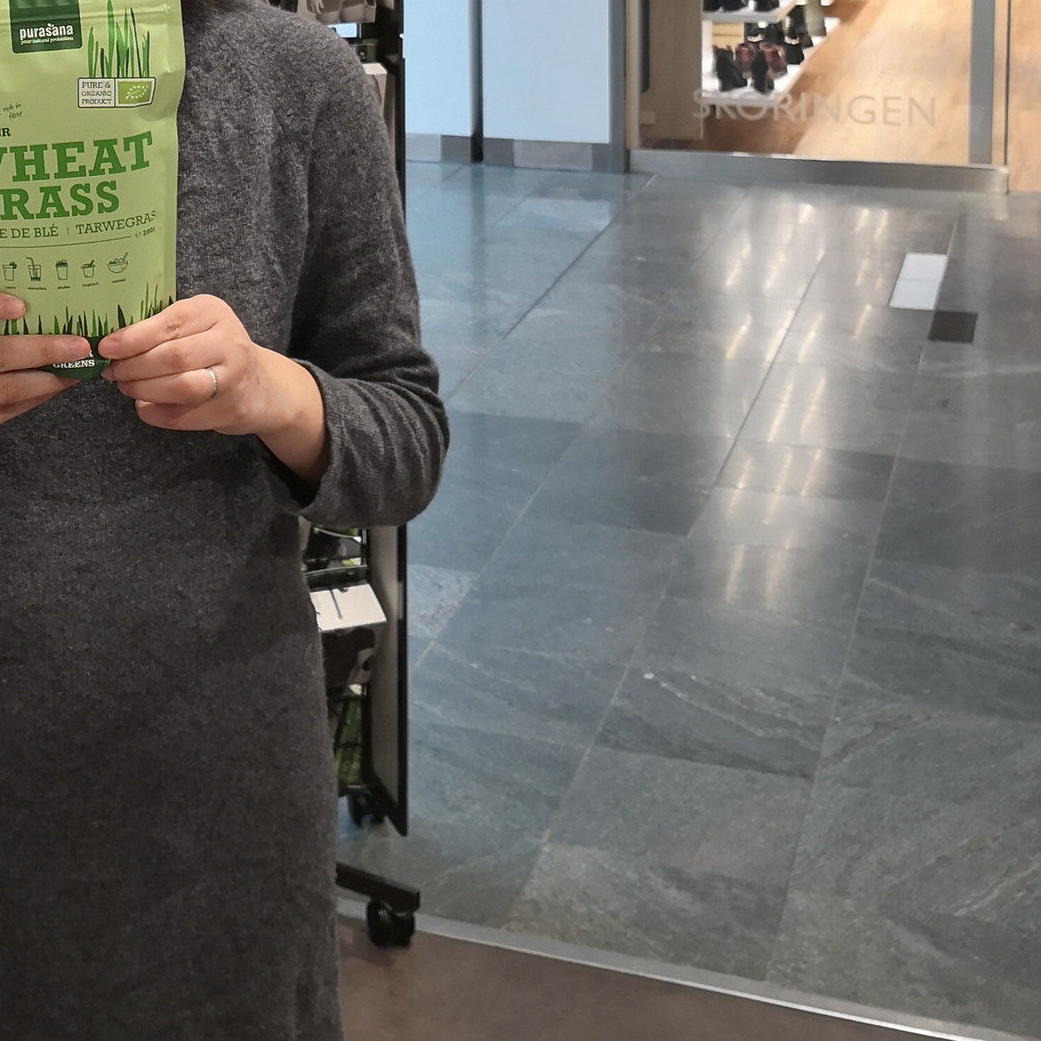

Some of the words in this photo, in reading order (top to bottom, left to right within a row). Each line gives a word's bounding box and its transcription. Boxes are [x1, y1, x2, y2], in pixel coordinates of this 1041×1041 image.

[19, 23, 74, 41] purasana
[82, 81, 103, 89] PURE
[693, 89, 937, 127] SKORINGEN
[11, 227, 30, 239] DE
[34, 222, 59, 238] BLÉ
[76, 210, 156, 235] TARWEGRAS
